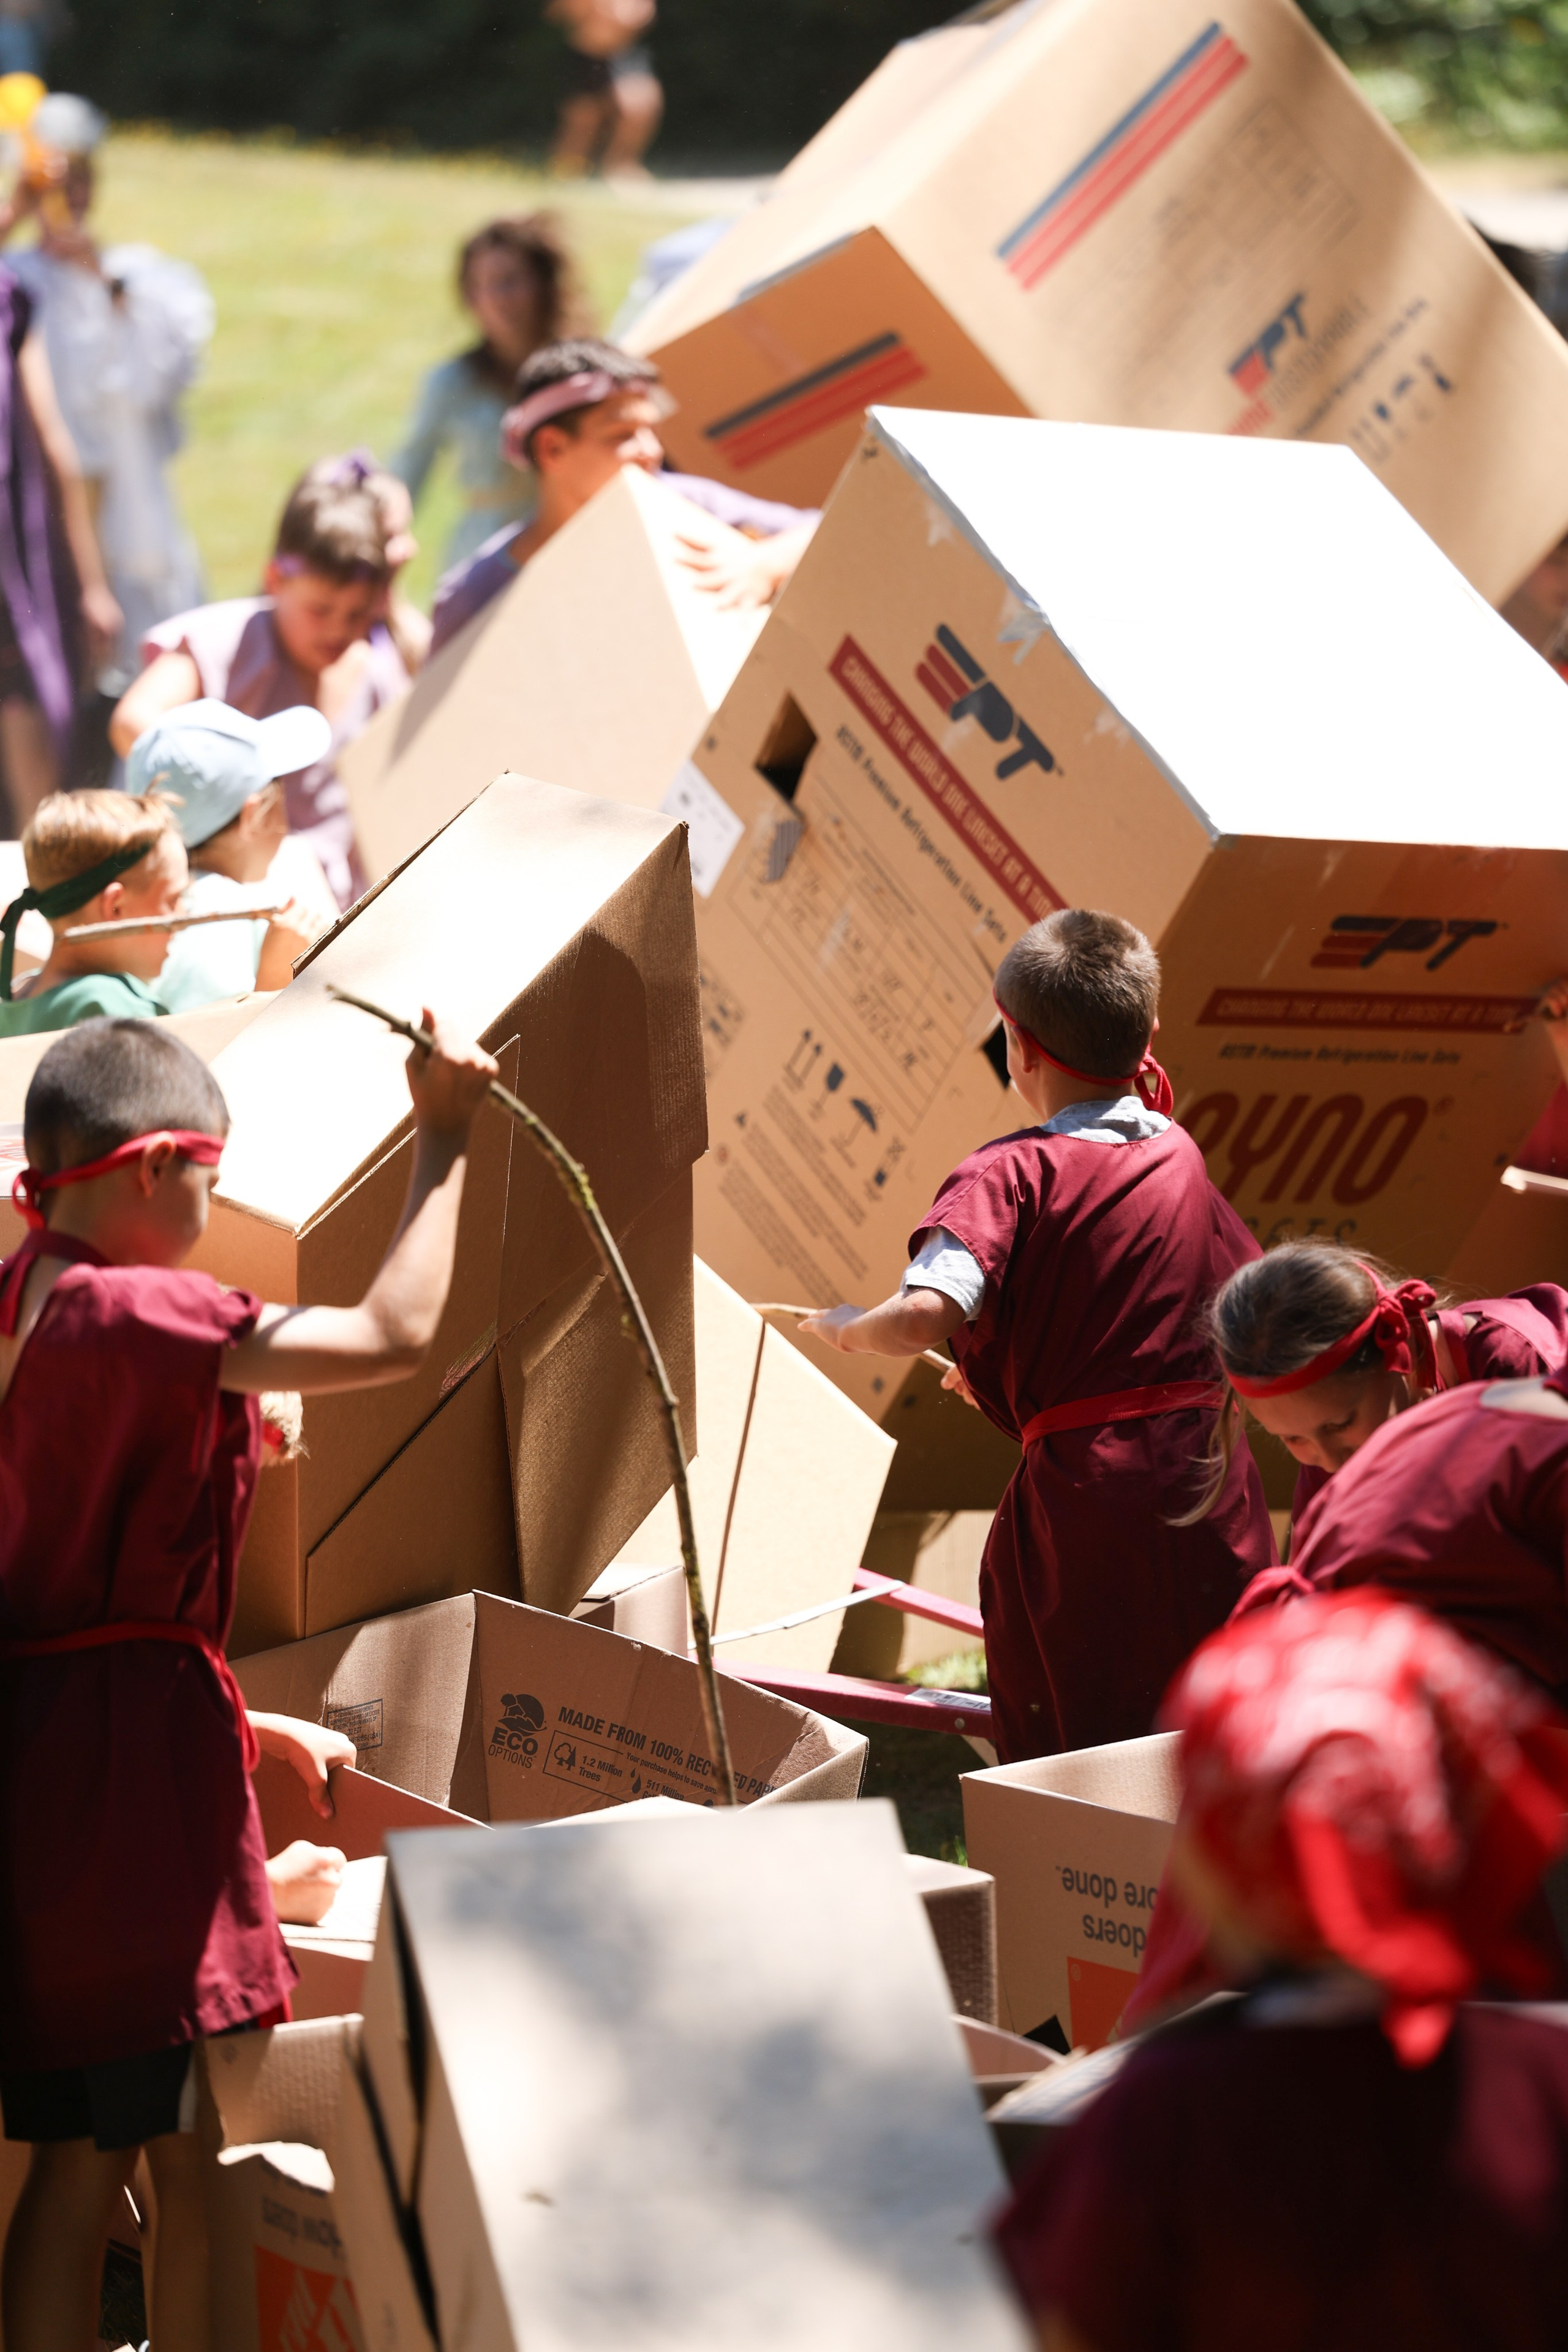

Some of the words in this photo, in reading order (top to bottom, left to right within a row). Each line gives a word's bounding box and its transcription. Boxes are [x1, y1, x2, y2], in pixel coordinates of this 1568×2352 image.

[842, 657, 896, 726] CHANGING
[889, 714, 915, 750] THE
[908, 740, 948, 794] WORLD
[941, 783, 970, 821] ONE
[962, 807, 1009, 866] LINESET
[1001, 857, 1024, 884] AT
[1016, 873, 1033, 897] A
[1027, 884, 1056, 919] TIM
[864, 757, 900, 810] Premium
[901, 807, 961, 888] Refrigeration
[960, 881, 982, 913] Line
[984, 908, 1007, 943] Sets
[1259, 1046, 1312, 1060] Premium
[1316, 1046, 1399, 1065] Refrigeration
[1401, 1048, 1429, 1063] Line
[355, 1705, 374, 1714] COMPONENTS
[491, 1727, 538, 1756] ECO
[558, 1706, 605, 1735] MADE
[607, 1722, 647, 1750] FROM
[650, 1739, 684, 1766] 100%
[685, 1753, 748, 1790] RECED
[488, 1744, 533, 1769] OPTIONS
[582, 1755, 596, 1768] 1.2
[597, 1760, 623, 1777] Million
[626, 1752, 639, 1763] Your
[639, 1759, 667, 1774] purchase
[668, 1768, 683, 1781] helps
[684, 1775, 690, 1784] to
[690, 1779, 704, 1789] save
[579, 1766, 601, 1782] Trees
[646, 1779, 660, 1792] 511
[660, 1784, 685, 1801] Million
[1061, 1867, 1118, 1909] done
[1123, 1881, 1159, 1910] ore
[1082, 1913, 1147, 1958] doers
